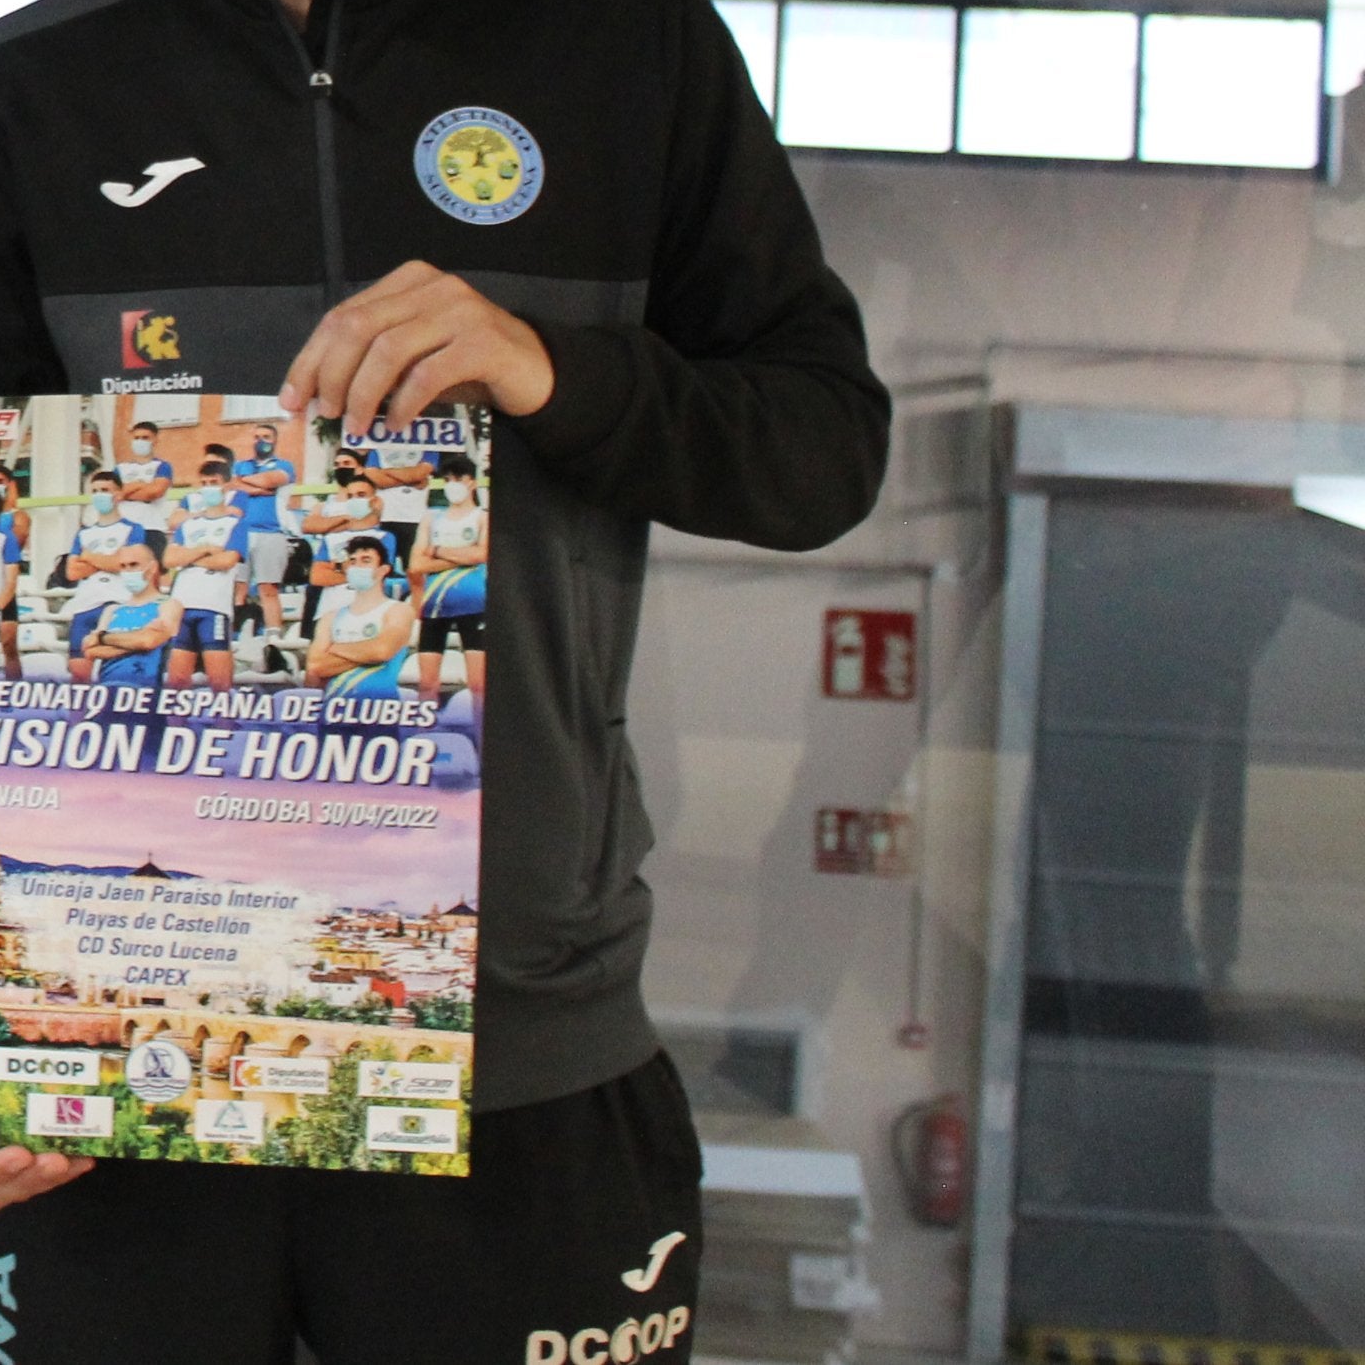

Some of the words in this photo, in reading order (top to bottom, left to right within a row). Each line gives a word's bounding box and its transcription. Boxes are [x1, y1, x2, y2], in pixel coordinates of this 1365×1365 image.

[101, 372, 203, 394] Diputación
[113, 687, 155, 714] DE
[155, 686, 274, 721] ESPAÑA
[280, 695, 323, 723] DE
[324, 697, 438, 728] CLUBES
[154, 726, 233, 778] DE
[238, 730, 437, 787] HONOR
[195, 792, 312, 824] CÓRDOBA
[318, 802, 438, 829] 30/04/2022
[21, 877, 93, 903] Unicaja
[98, 883, 145, 902] Jaen
[150, 885, 222, 907] Paraiso
[227, 889, 299, 909] Interior
[66, 908, 128, 932] Playas
[133, 911, 156, 930] de
[77, 936, 104, 954] CD
[109, 937, 164, 958] Surco
[169, 941, 238, 962] Lucena
[124, 965, 191, 986] CAPEX
